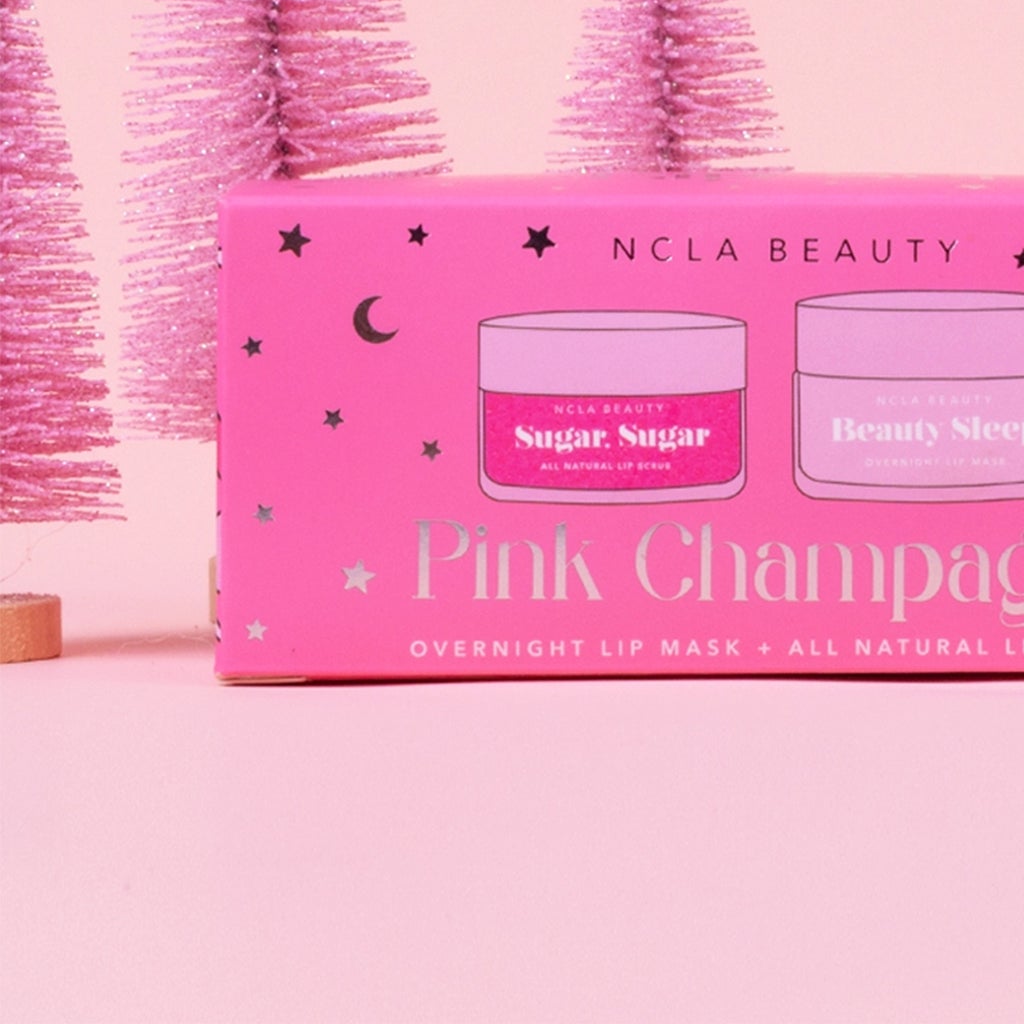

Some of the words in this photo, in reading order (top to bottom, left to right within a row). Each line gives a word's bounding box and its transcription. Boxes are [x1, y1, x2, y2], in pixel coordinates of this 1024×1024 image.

[613, 236, 738, 262] NCLA
[769, 237, 959, 264] BEAUTY
[554, 404, 596, 415] NCLA
[603, 404, 664, 414] BEAUTY
[874, 396, 919, 406] NCLA
[928, 395, 992, 406] BEAUTY
[618, 424, 710, 452] Sugar
[832, 417, 939, 447] Beauty
[540, 462, 560, 471] ALL
[564, 462, 614, 471] NATURAL
[618, 462, 634, 471] LIP
[637, 462, 671, 470] SCRUB
[411, 519, 603, 601] Pink
[410, 640, 584, 658] OVERNIGHT
[601, 640, 643, 656] LIP
[660, 639, 740, 656] MASK
[788, 639, 838, 656] ALL
[855, 638, 988, 656] NATURAL
